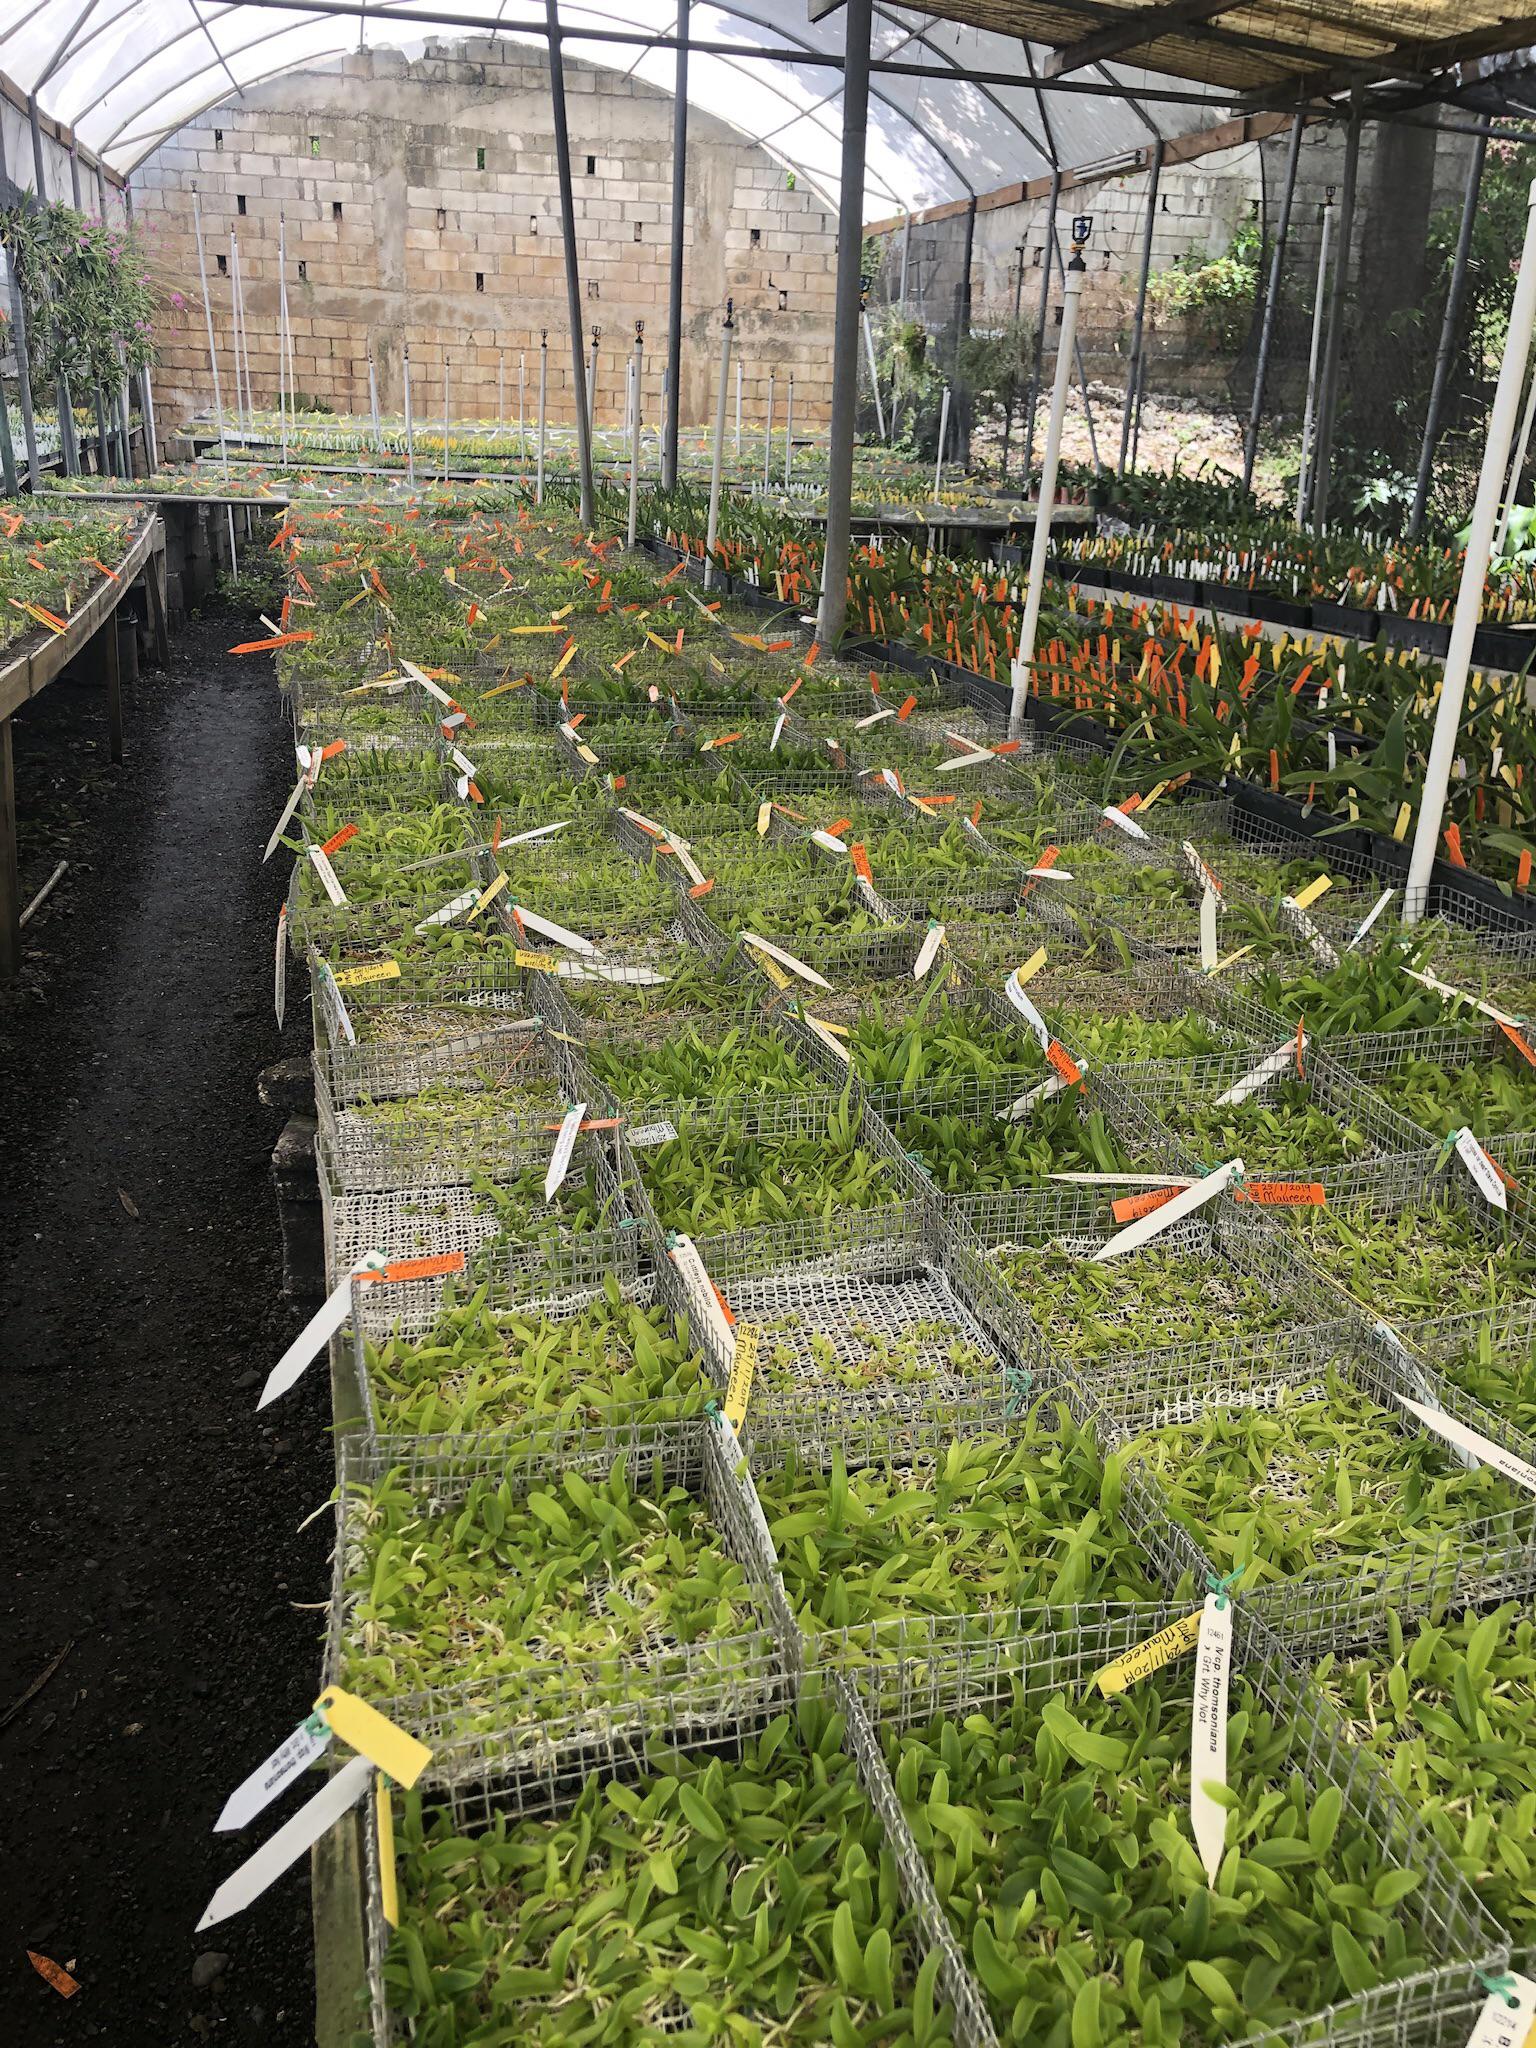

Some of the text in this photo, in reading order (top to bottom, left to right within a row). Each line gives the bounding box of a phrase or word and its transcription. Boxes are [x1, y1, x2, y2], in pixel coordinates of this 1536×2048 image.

[1263, 1191, 1314, 1206] Maureen
[727, 1339, 747, 1402] Maureen
[1207, 1627, 1224, 1640] 12461
[1199, 1678, 1211, 1702] Why
[1199, 1704, 1208, 1723] Not
[1210, 1677, 1222, 1753] thomsoniana
